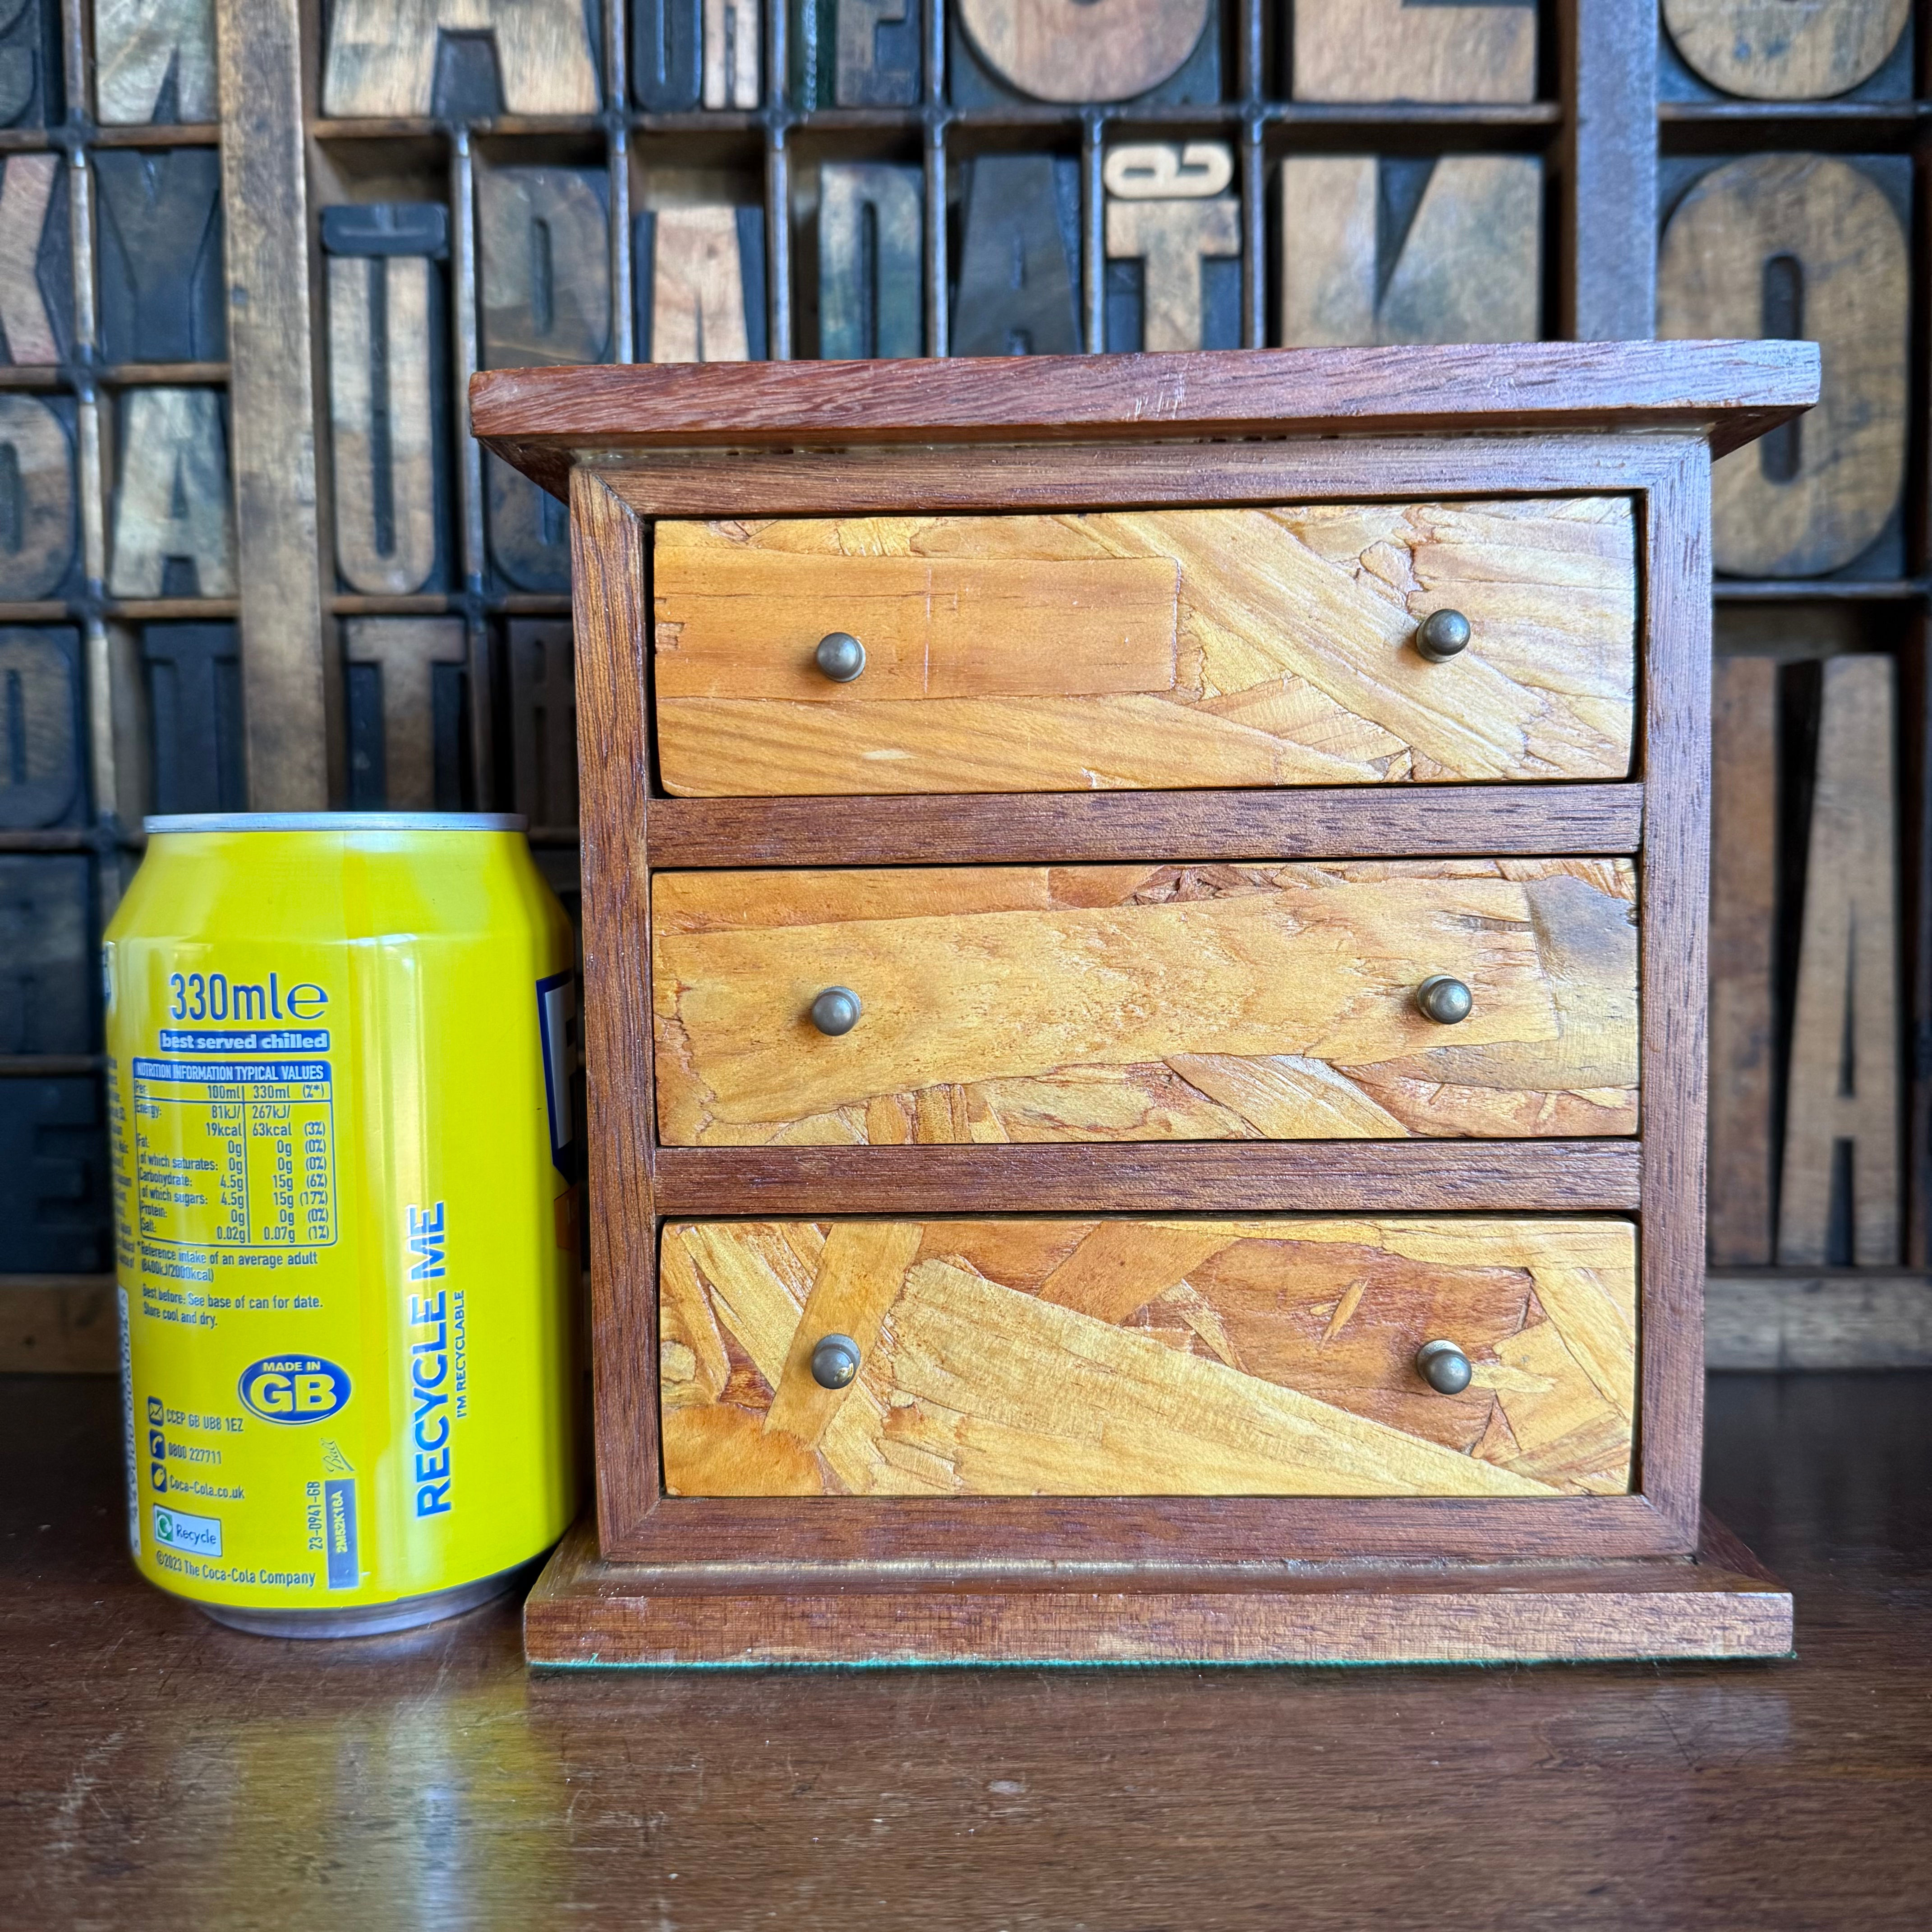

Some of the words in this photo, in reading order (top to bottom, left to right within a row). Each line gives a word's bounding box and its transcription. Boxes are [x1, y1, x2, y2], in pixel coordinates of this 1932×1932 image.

[161, 1033, 195, 1049] best
[197, 1034, 257, 1049] served
[262, 1033, 328, 1049] chilled
[137, 1062, 171, 1079] NUTRITION
[173, 1064, 233, 1081] INFORMATION
[235, 1066, 279, 1081] TYPICAL
[281, 1065, 324, 1080] VALUES
[207, 1085, 239, 1099] 100ml
[253, 1085, 290, 1099] 330ml
[212, 1105, 240, 1119] 81kJ/
[253, 1105, 290, 1119] 267kJ/
[206, 1122, 242, 1136] 19kcal
[253, 1122, 292, 1136] 63kcal
[304, 1122, 326, 1136] (3%)
[228, 1140, 242, 1157] 0g
[277, 1140, 292, 1157] 0g
[305, 1139, 326, 1155] (0%)
[140, 1151, 147, 1164] of
[148, 1154, 170, 1168] which
[173, 1159, 218, 1171] saturates:
[229, 1157, 243, 1174] 0g
[277, 1157, 292, 1174] 0g
[306, 1156, 327, 1171] (0%)
[139, 1168, 193, 1187] Carbohydrate:
[220, 1175, 244, 1191] 4.5g
[273, 1174, 293, 1191] 15g
[306, 1173, 327, 1188] (6%)
[142, 1185, 148, 1198] of
[150, 1187, 171, 1201] which
[174, 1193, 208, 1207] sugars:
[220, 1192, 244, 1209] 4.5g
[273, 1191, 294, 1209] 15g
[300, 1191, 328, 1206] (17%)
[141, 1201, 167, 1218] Protein:
[230, 1209, 245, 1226] 0g
[280, 1209, 294, 1226] 0g
[308, 1208, 329, 1223] (0%)
[216, 1226, 245, 1243] 0.02g
[264, 1226, 295, 1243] 0.07g
[308, 1225, 329, 1240] (1%)
[406, 1201, 446, 1281] ME
[179, 1248, 206, 1264] intake
[209, 1251, 219, 1265] of
[222, 1255, 234, 1265] an
[238, 1256, 283, 1269] average
[288, 1251, 318, 1265] adult
[143, 1283, 157, 1299] Best
[158, 1286, 185, 1304] before:
[188, 1292, 205, 1306] See
[207, 1294, 231, 1308] base
[235, 1295, 245, 1308] of
[249, 1298, 269, 1308] can
[273, 1295, 290, 1308] for
[294, 1295, 323, 1308] date.
[163, 1308, 179, 1322] cool
[181, 1311, 197, 1324] and
[200, 1312, 218, 1329] dry.
[454, 1289, 466, 1392] RECYCLABLE
[263, 1362, 303, 1371] MADE
[307, 1361, 321, 1371] IN
[250, 1373, 337, 1412] GB
[408, 1290, 452, 1518] RECYCLE
[456, 1394, 468, 1419] I'M
[166, 1408, 185, 1425] CCEP
[189, 1414, 200, 1428] GB
[204, 1416, 221, 1430] UB8
[225, 1418, 244, 1432] 1EZ
[168, 1442, 187, 1459] 0800
[189, 1448, 221, 1464] 227711
[170, 1475, 245, 1499] Coca-Cola.co.uk
[307, 1481, 322, 1550] 23-0941-GB
[176, 1524, 216, 1545] Recycle
[184, 1560, 199, 1576] The
[202, 1565, 256, 1584] Coca-Cola
[259, 1569, 316, 1587] Company
